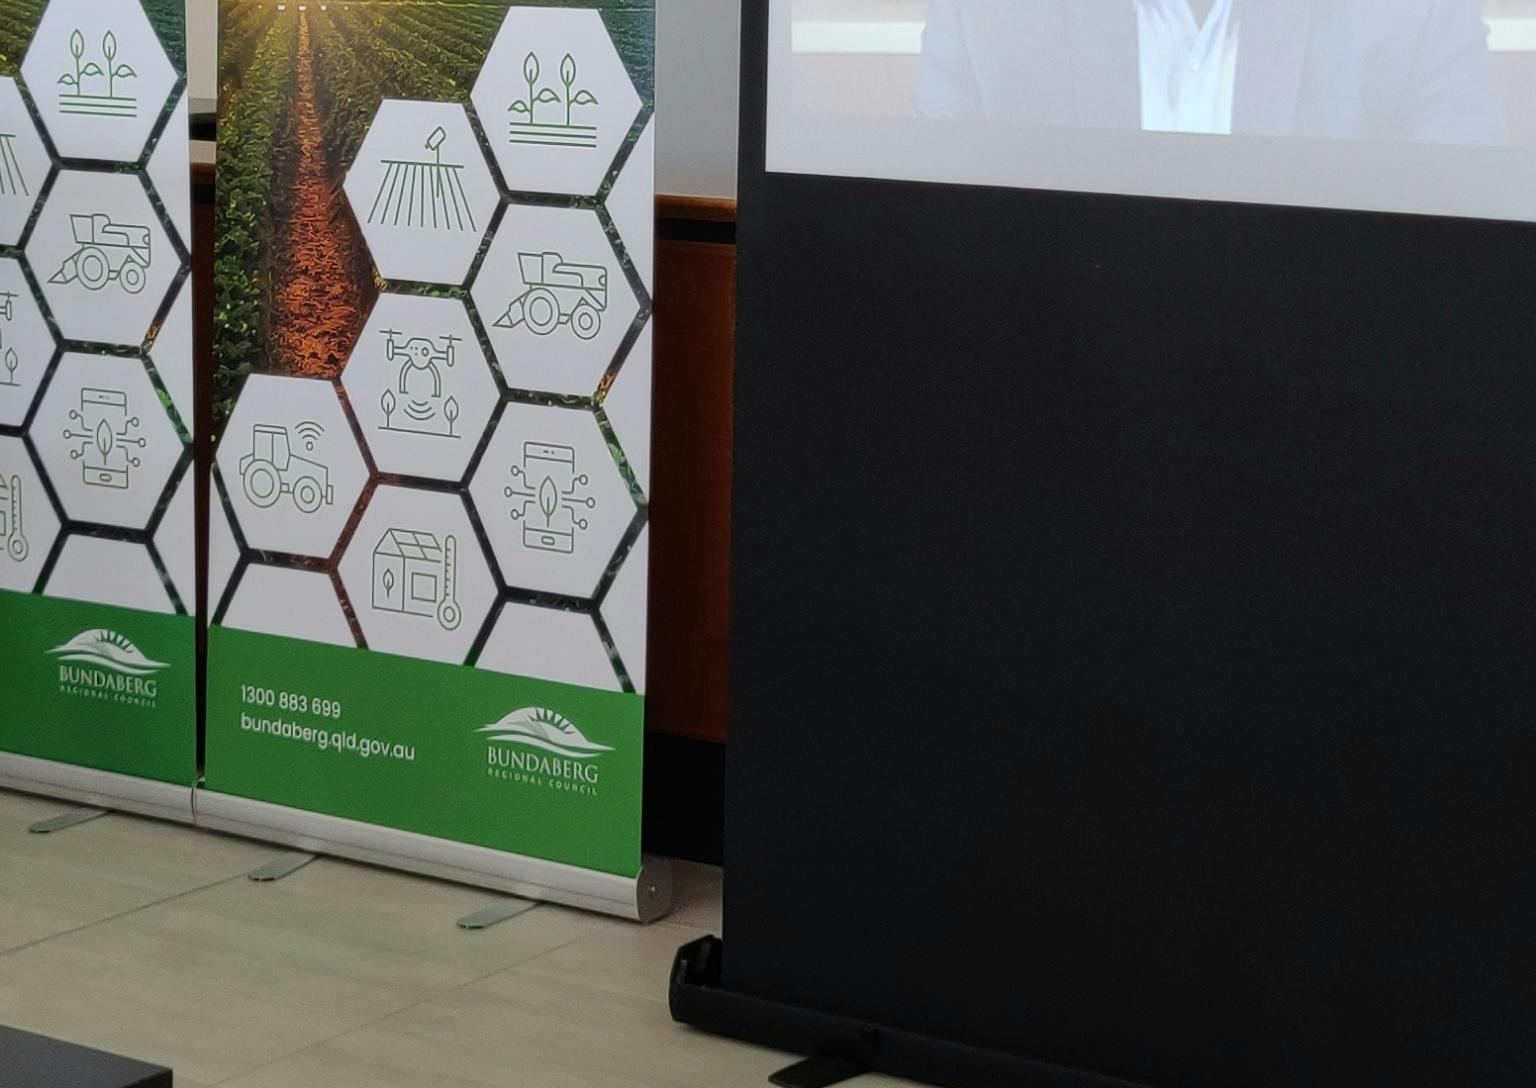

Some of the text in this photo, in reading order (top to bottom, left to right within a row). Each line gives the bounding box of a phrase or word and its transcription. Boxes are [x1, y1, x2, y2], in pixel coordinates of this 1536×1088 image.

[59, 665, 157, 698] BUNDABERG
[241, 684, 341, 718] 1300 883 699
[241, 712, 415, 760] bundaberg.qld.gov.au
[487, 767, 598, 796] REGIONAL COUNCIL
[488, 746, 599, 783] BUNDABERG
